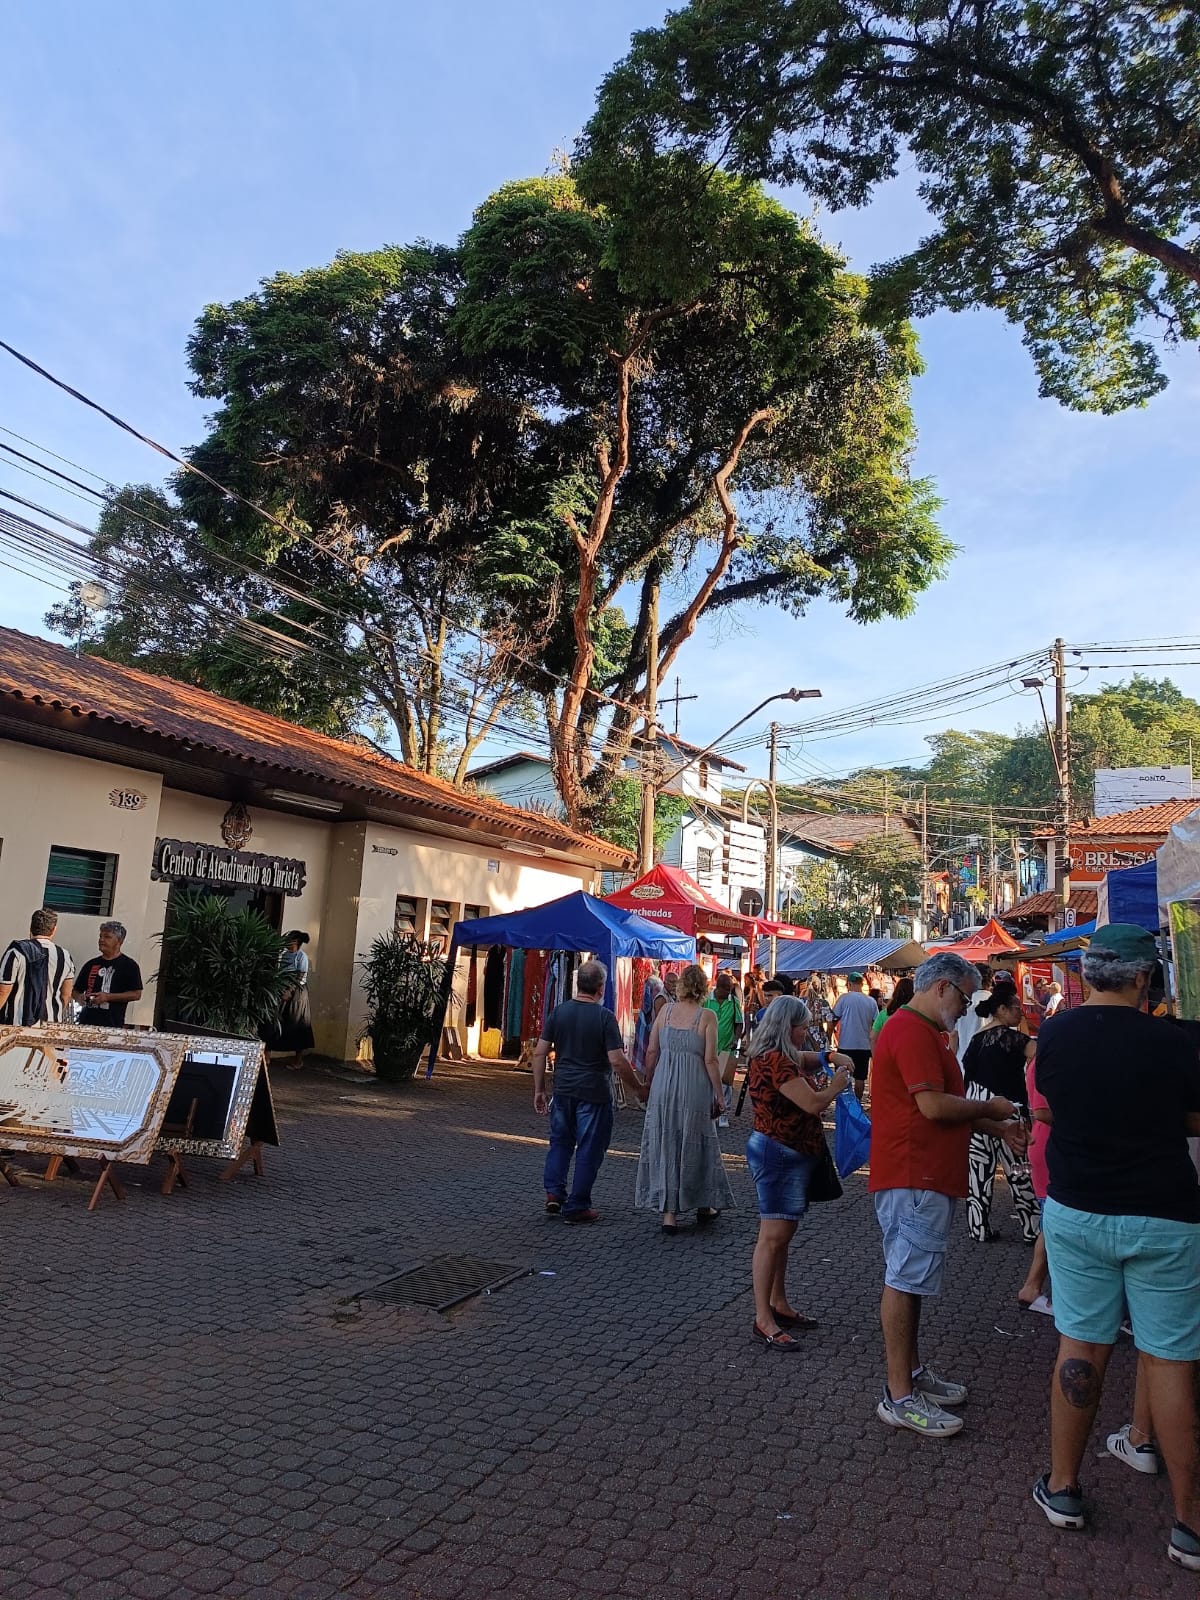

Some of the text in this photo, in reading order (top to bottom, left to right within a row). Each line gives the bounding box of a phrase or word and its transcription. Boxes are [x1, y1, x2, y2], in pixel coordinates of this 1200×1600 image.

[119, 791, 142, 807] 139
[162, 844, 300, 890] Centro de Atendimento ao Turista
[629, 907, 673, 918] recheados
[904, 1411, 928, 1428] FILA
